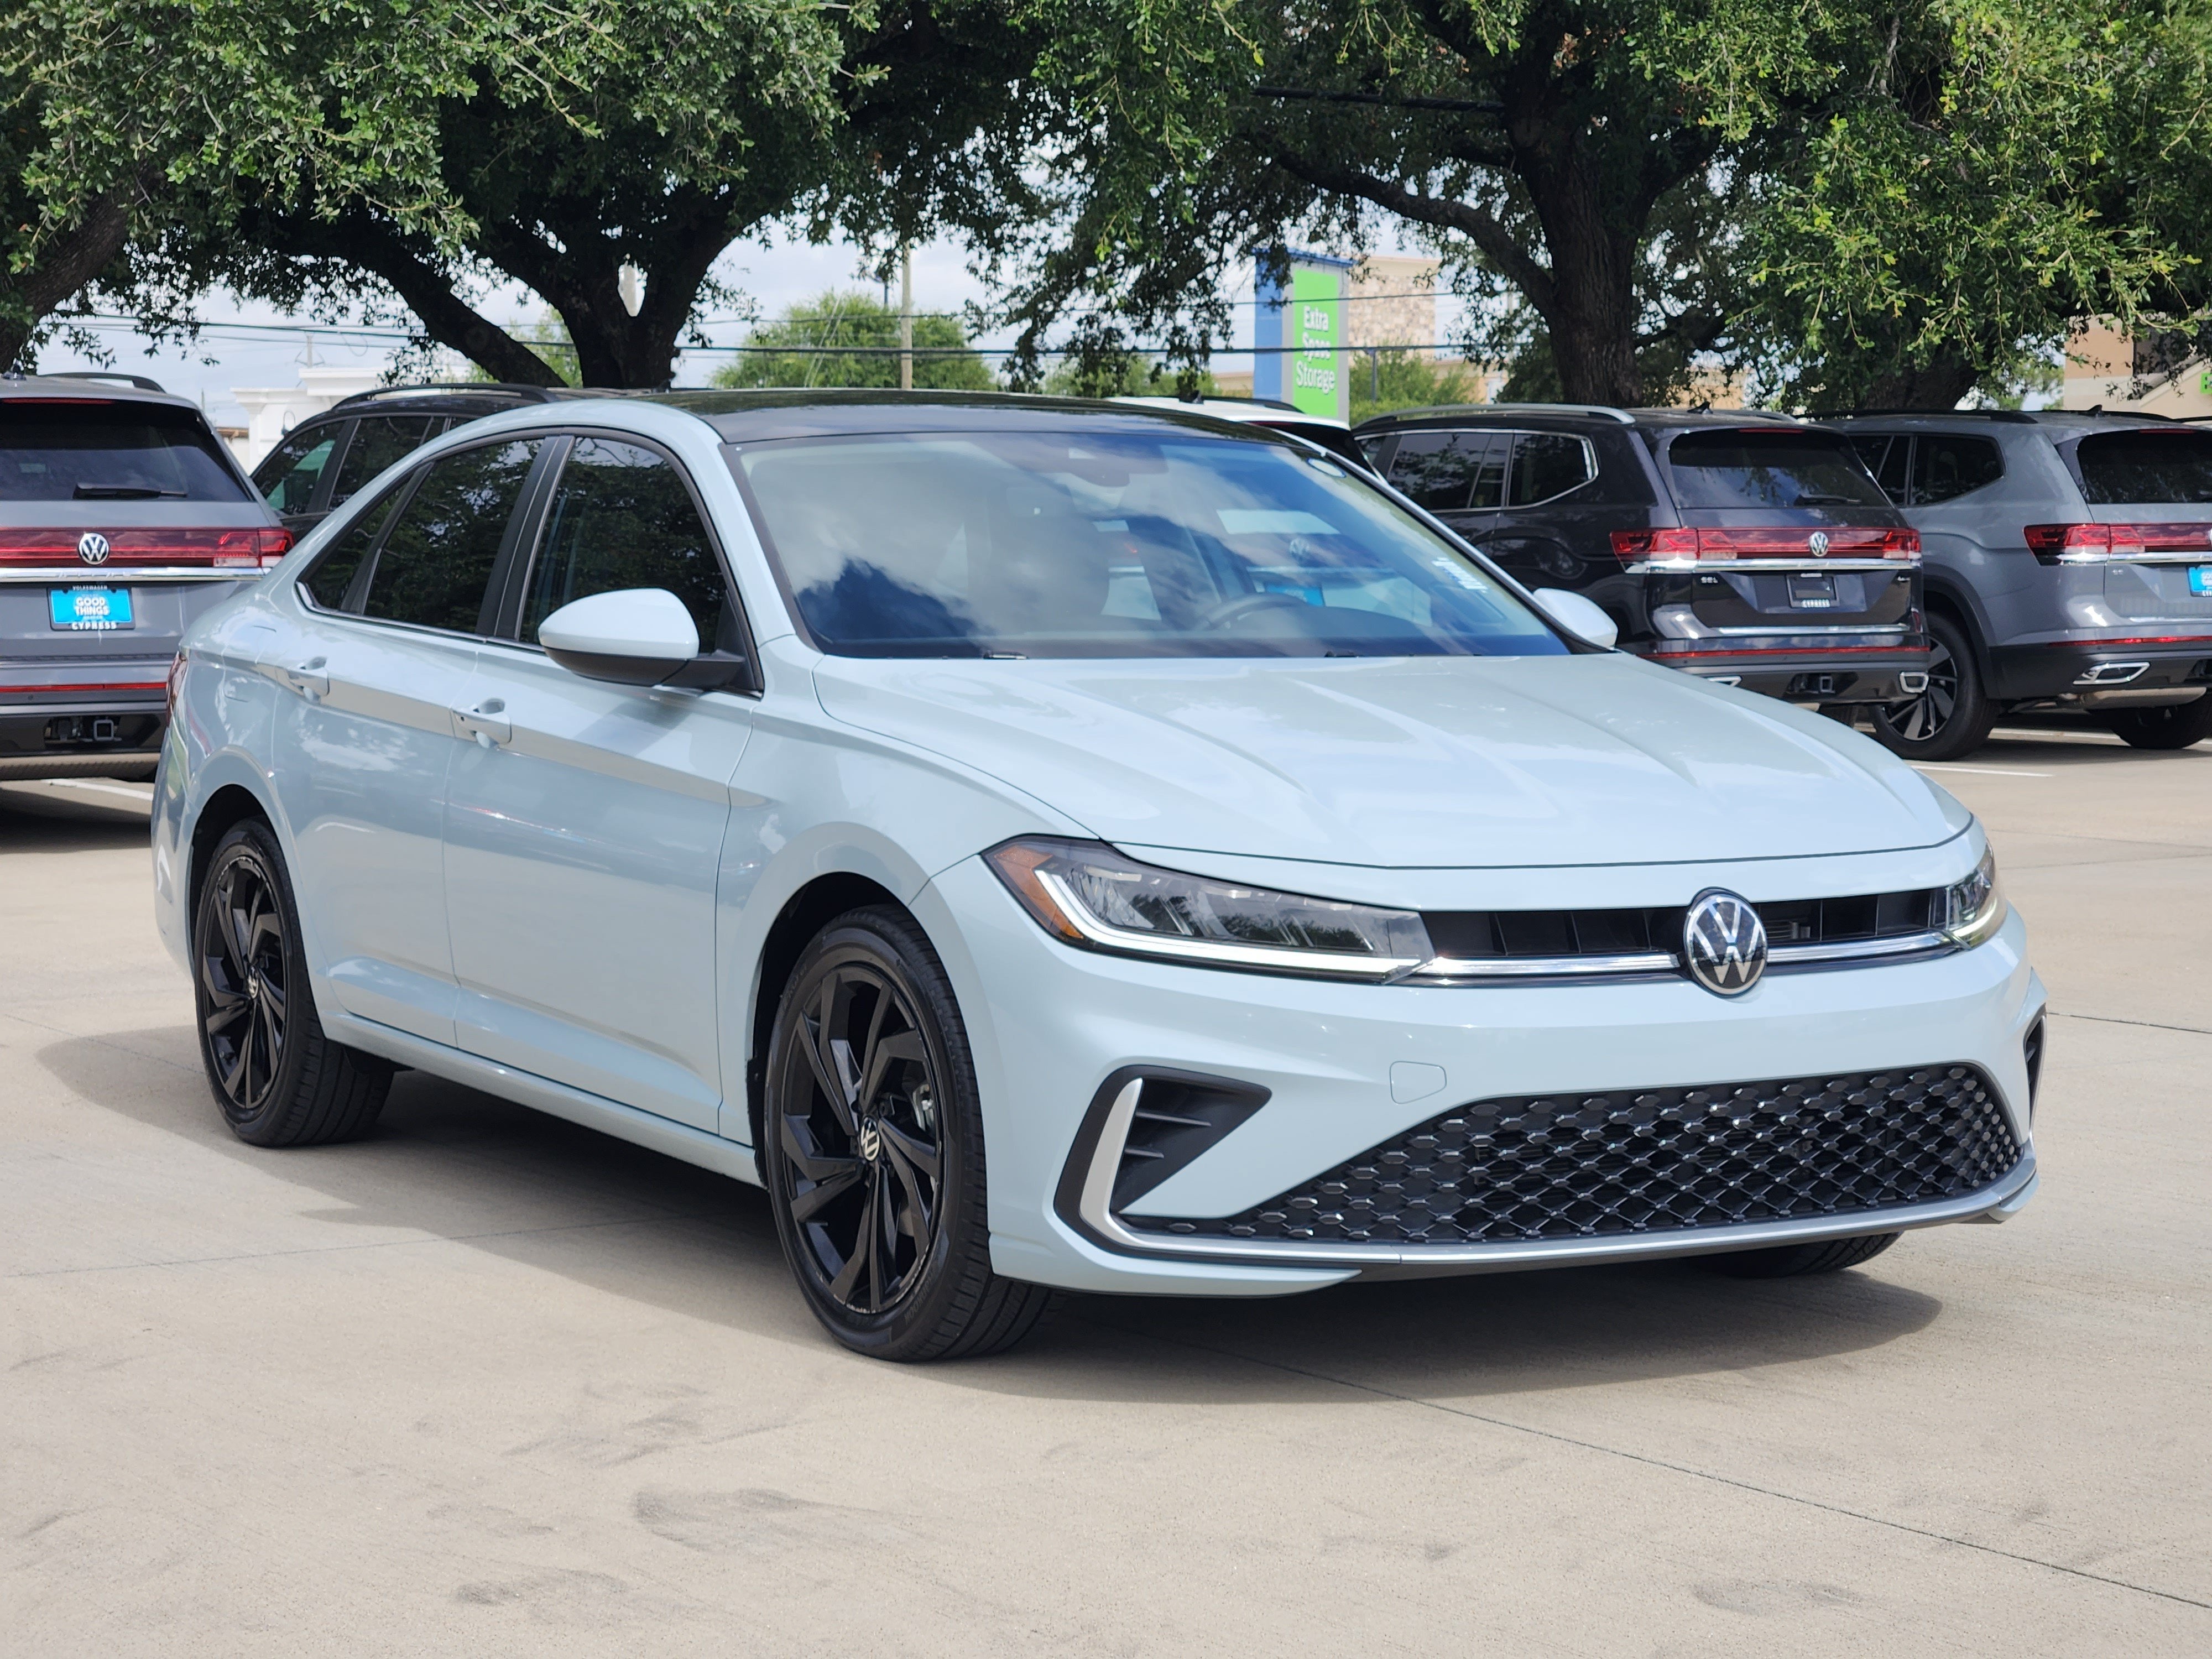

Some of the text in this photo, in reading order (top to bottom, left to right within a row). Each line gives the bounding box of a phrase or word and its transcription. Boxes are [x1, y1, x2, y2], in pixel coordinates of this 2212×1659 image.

[1304, 305, 1328, 332] Extra
[1303, 332, 1331, 362] Space
[1296, 361, 1335, 395] Storage
[75, 606, 110, 616] THINGS
[76, 597, 106, 607] GOOD
[71, 620, 117, 630] CYPRESS
[1686, 894, 1767, 995] VW
